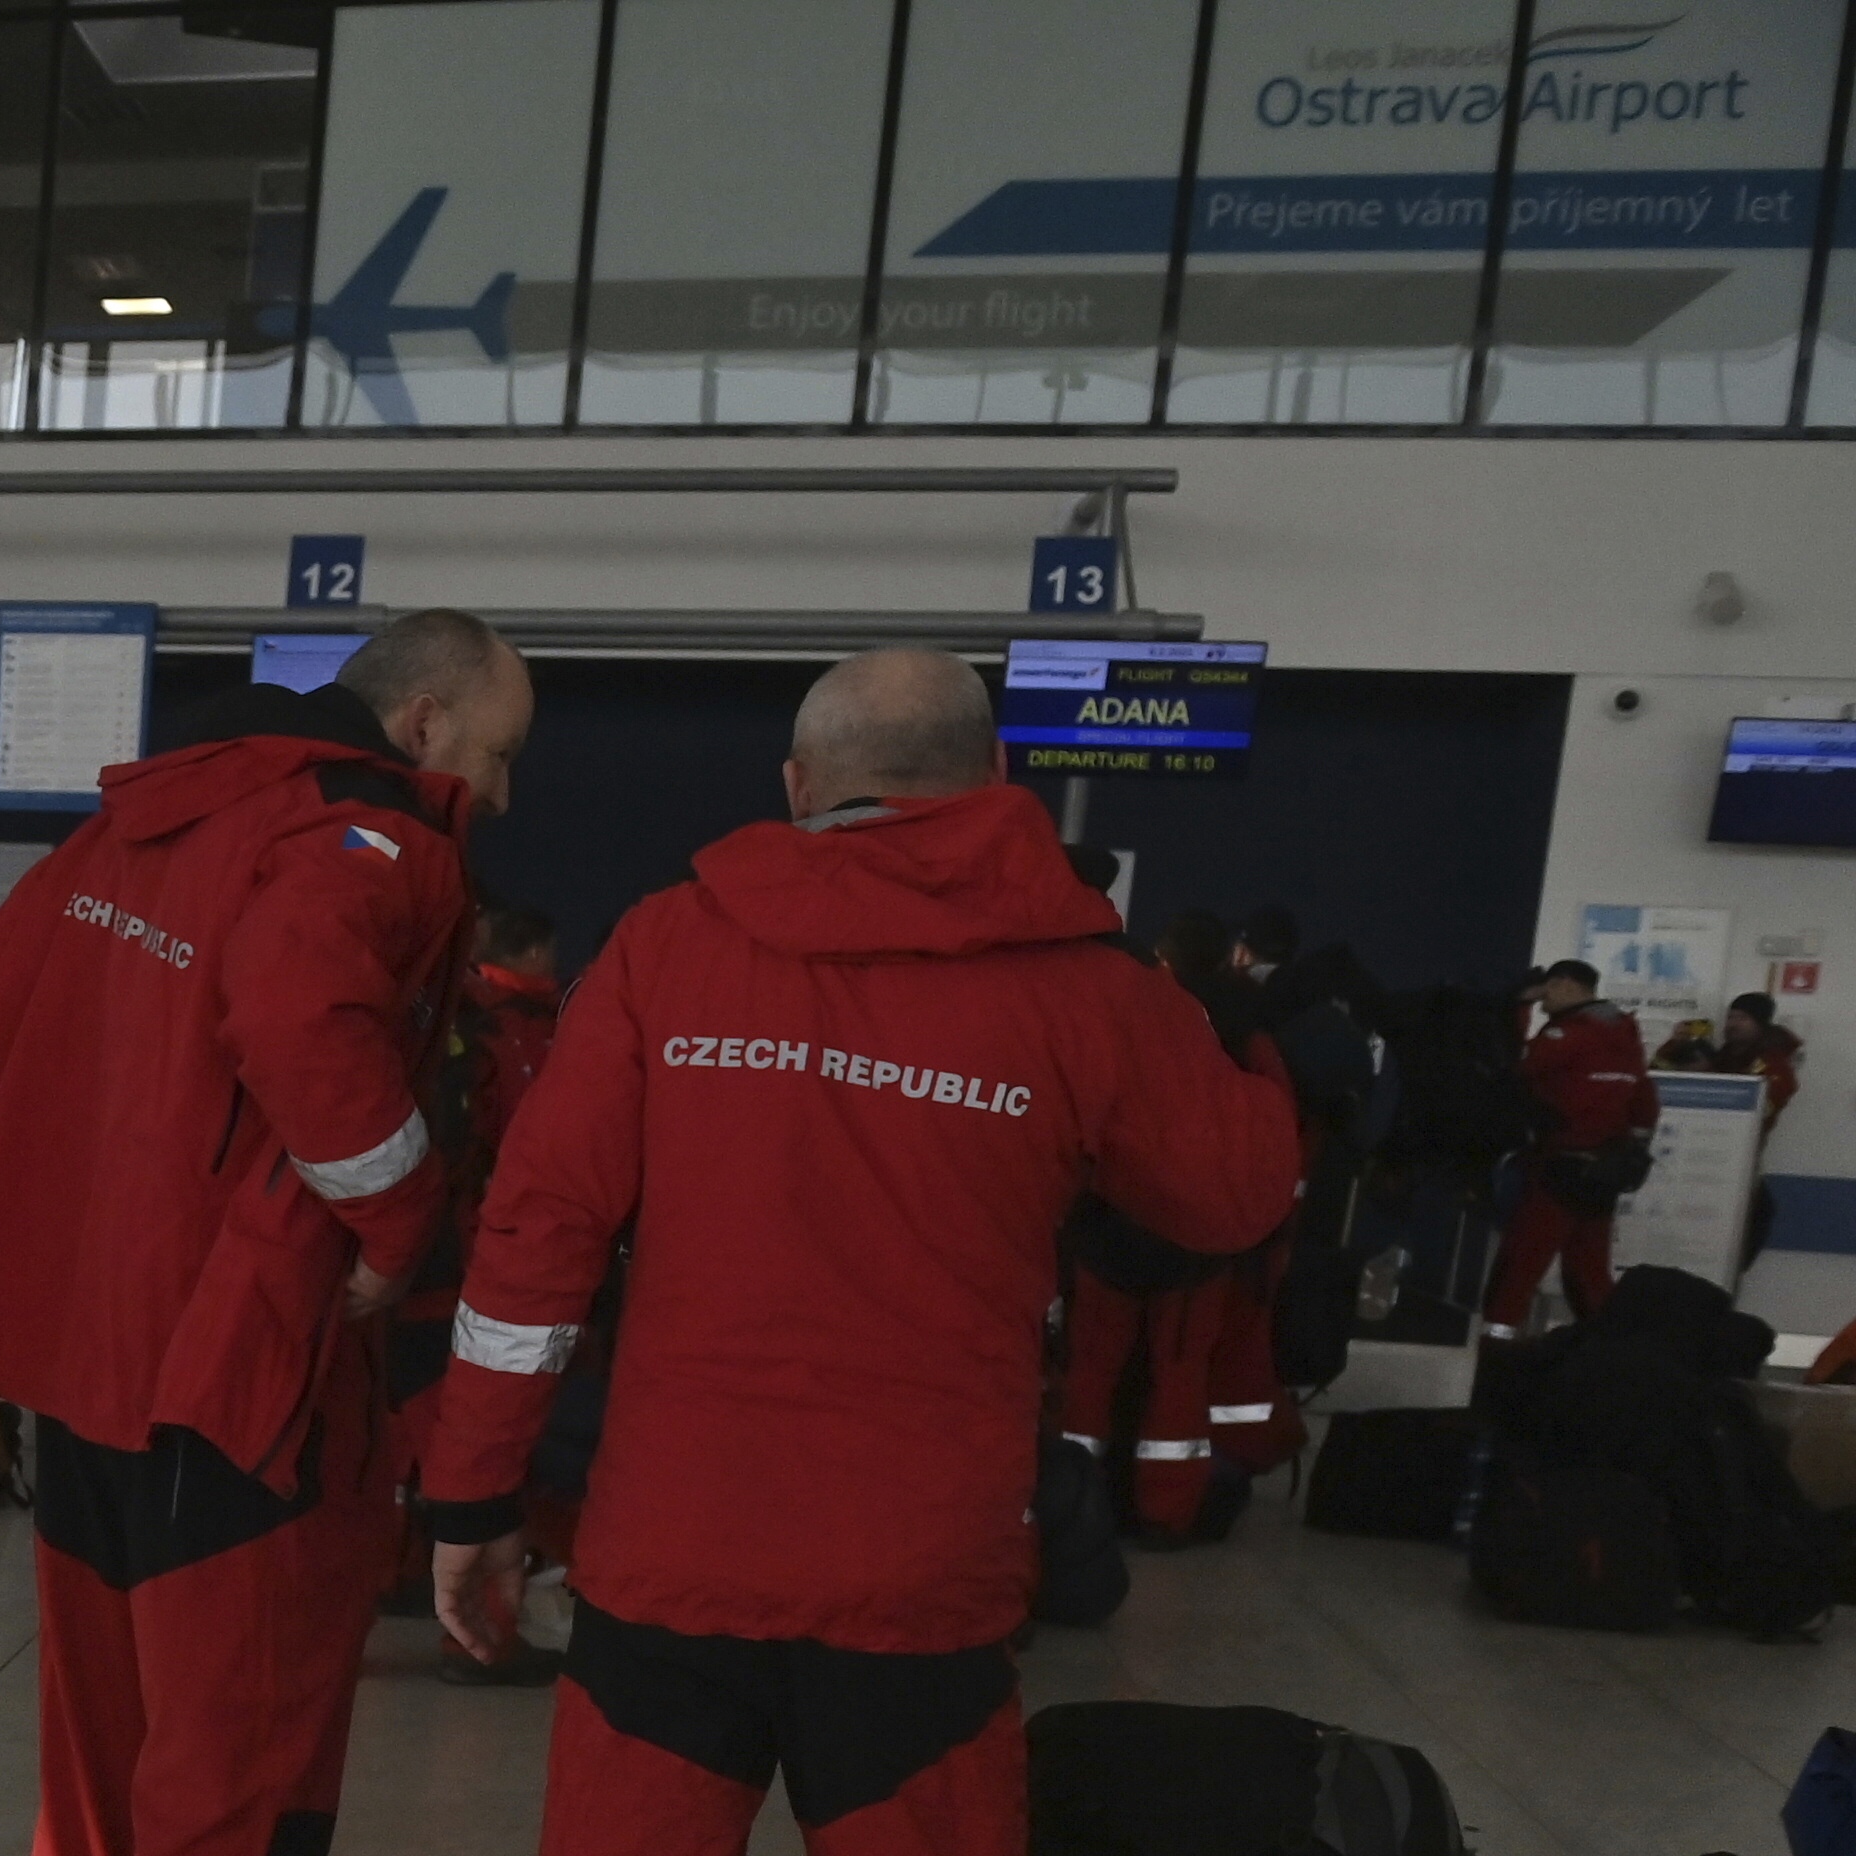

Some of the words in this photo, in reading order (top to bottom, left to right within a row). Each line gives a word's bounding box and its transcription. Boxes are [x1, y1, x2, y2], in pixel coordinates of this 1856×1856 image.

[1257, 76, 1504, 128] Ostrava
[1521, 69, 1751, 134] Airport
[1735, 184, 1794, 223] let
[748, 294, 861, 339] Enjoy
[300, 561, 356, 600] 12
[1046, 564, 1105, 605] 13
[1077, 696, 1190, 727] ADANA
[1027, 750, 1151, 769] DEPARTURE
[663, 1036, 809, 1072] CZECH
[820, 1048, 1032, 1117] REPUBLIC
